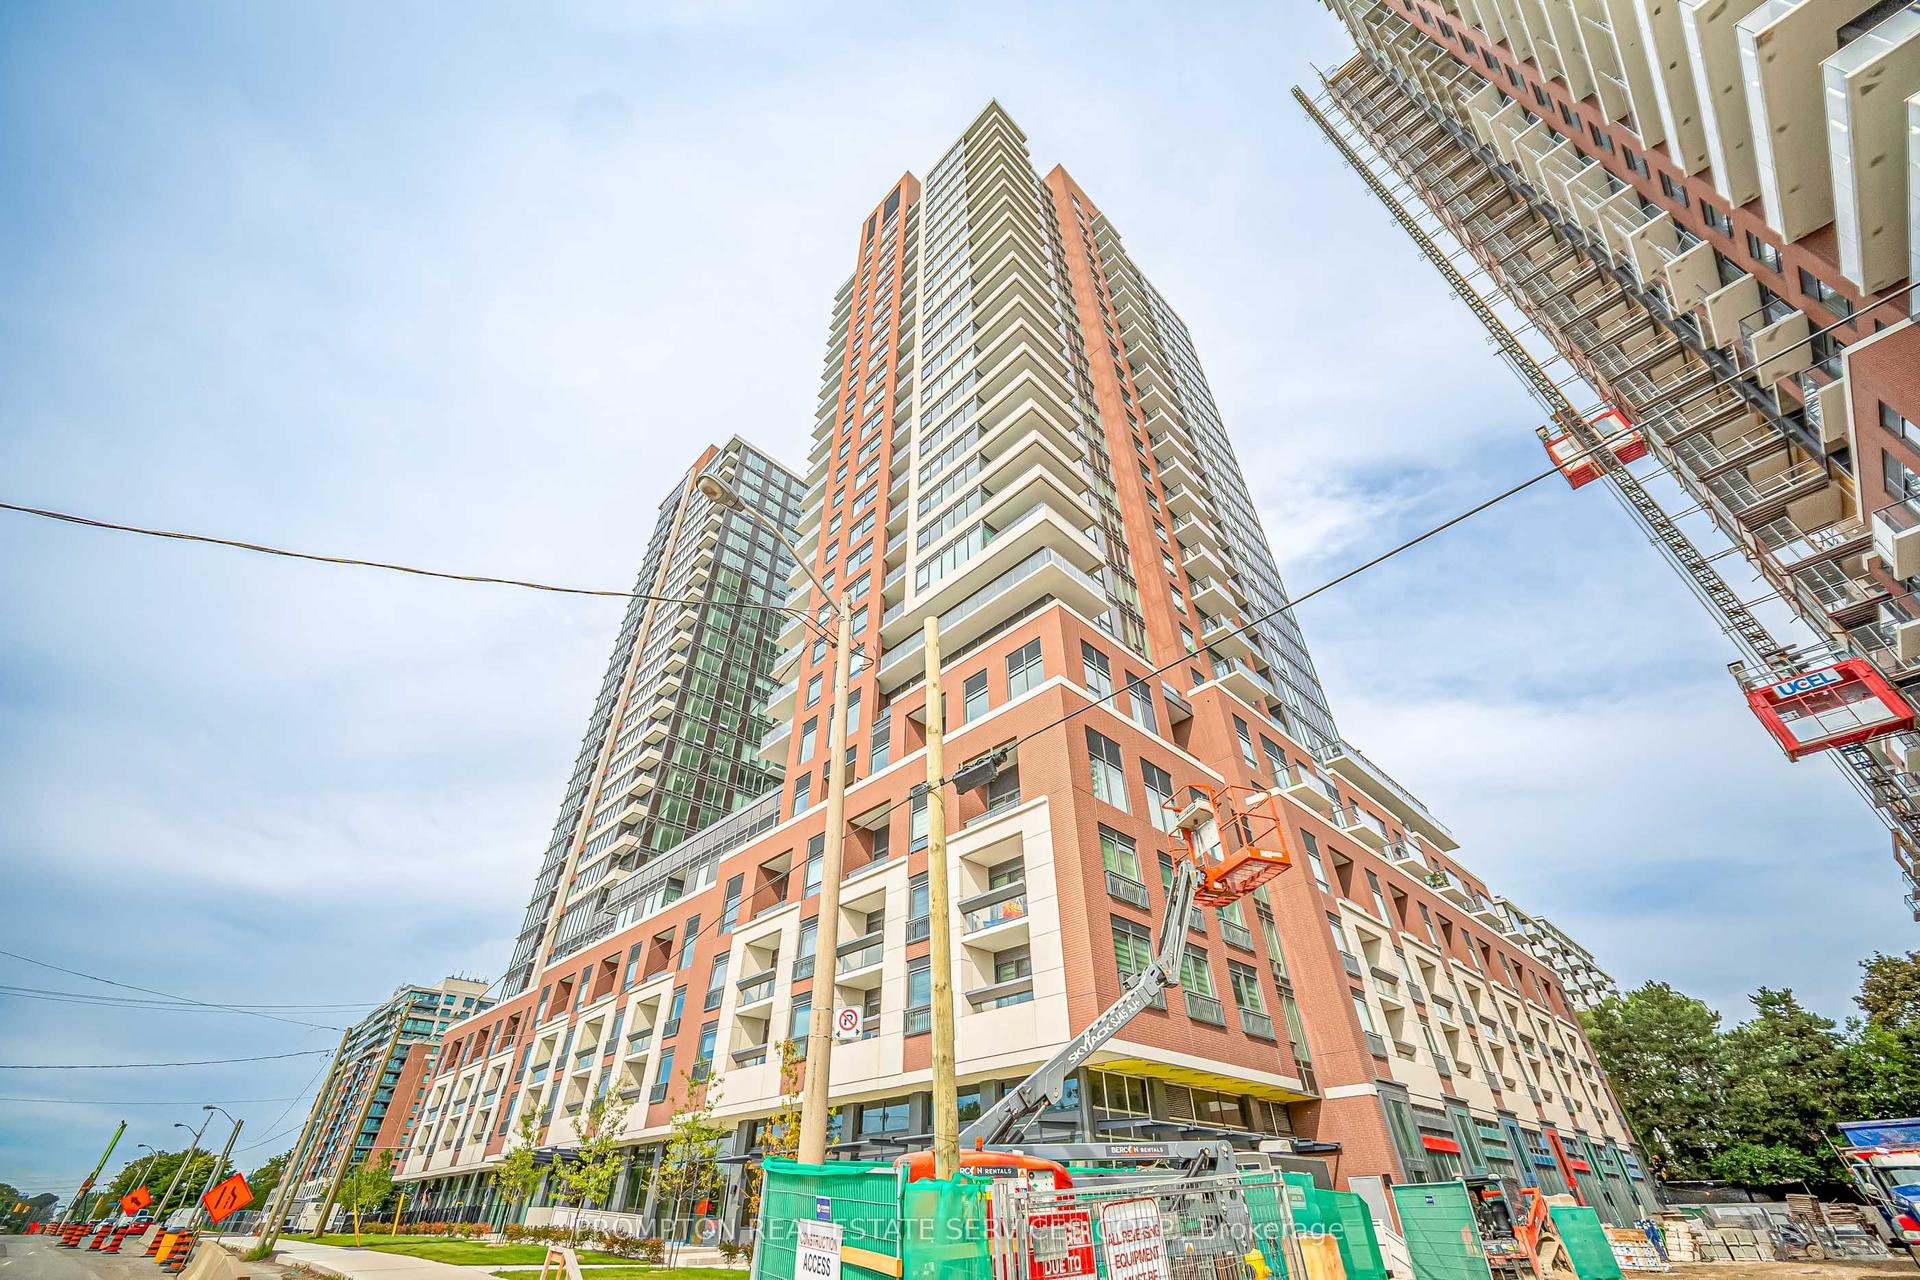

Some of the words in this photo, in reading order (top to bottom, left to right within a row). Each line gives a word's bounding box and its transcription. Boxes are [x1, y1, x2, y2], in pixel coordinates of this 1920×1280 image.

[1777, 673, 1836, 695] UCEL
[1068, 1024, 1113, 1064] SKYJACK
[1108, 1232, 1122, 1246] ALL
[803, 1253, 831, 1277] ACCESS
[1045, 1258, 1067, 1275] DUE
[1068, 1255, 1082, 1271] TO
[1115, 1245, 1160, 1269] EQUIPMENT
